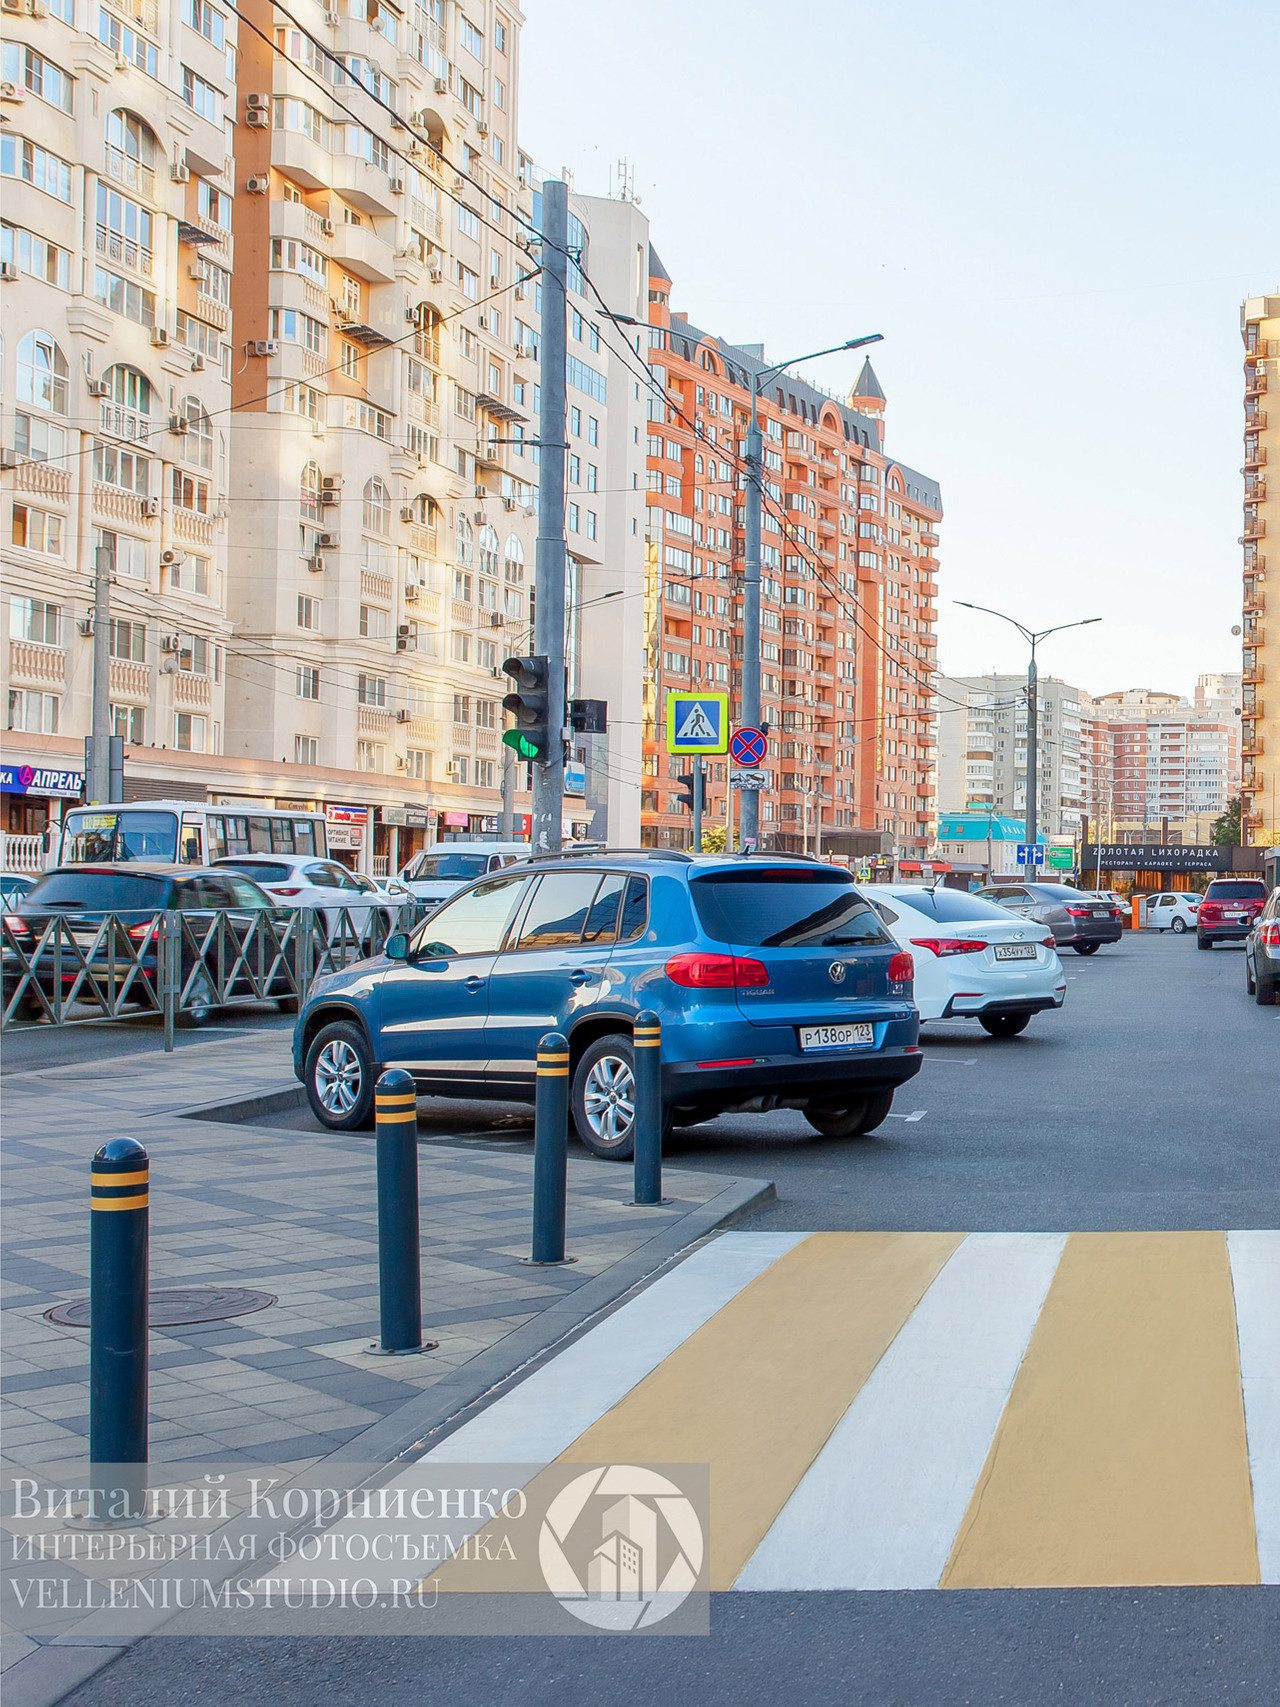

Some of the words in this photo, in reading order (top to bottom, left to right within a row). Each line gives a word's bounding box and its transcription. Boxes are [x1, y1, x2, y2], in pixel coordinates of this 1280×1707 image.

[31, 770, 82, 790] АПРЕЛЬ
[327, 828, 350, 836] ОРТИВНОЕ
[1024, 946, 1034, 954] 123
[854, 1024, 871, 1038] 123
